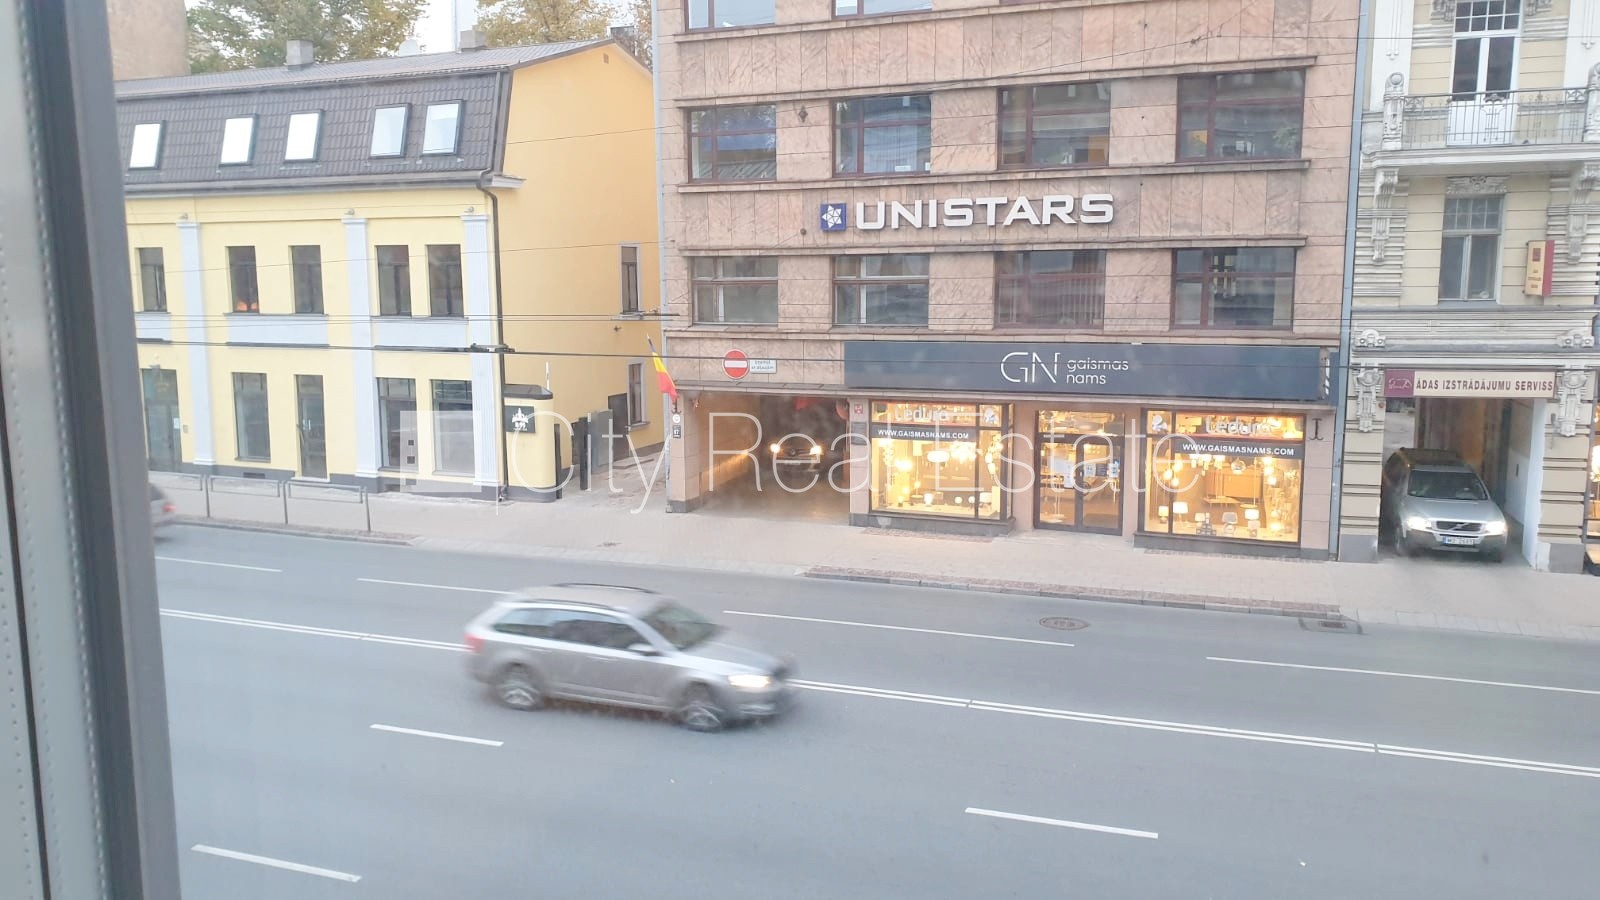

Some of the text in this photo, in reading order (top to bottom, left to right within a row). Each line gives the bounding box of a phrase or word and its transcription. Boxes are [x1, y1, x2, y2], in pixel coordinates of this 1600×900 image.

[856, 193, 1114, 231] UNISTARS
[1000, 351, 1061, 384] GN
[1066, 357, 1129, 373] gaismas
[1066, 374, 1107, 385] nams
[1514, 380, 1553, 391] SERVISS
[877, 428, 970, 440] WWW.GAISMASNAMS.COM
[1182, 442, 1295, 456] WWW.GAISMASNAMS.COM
